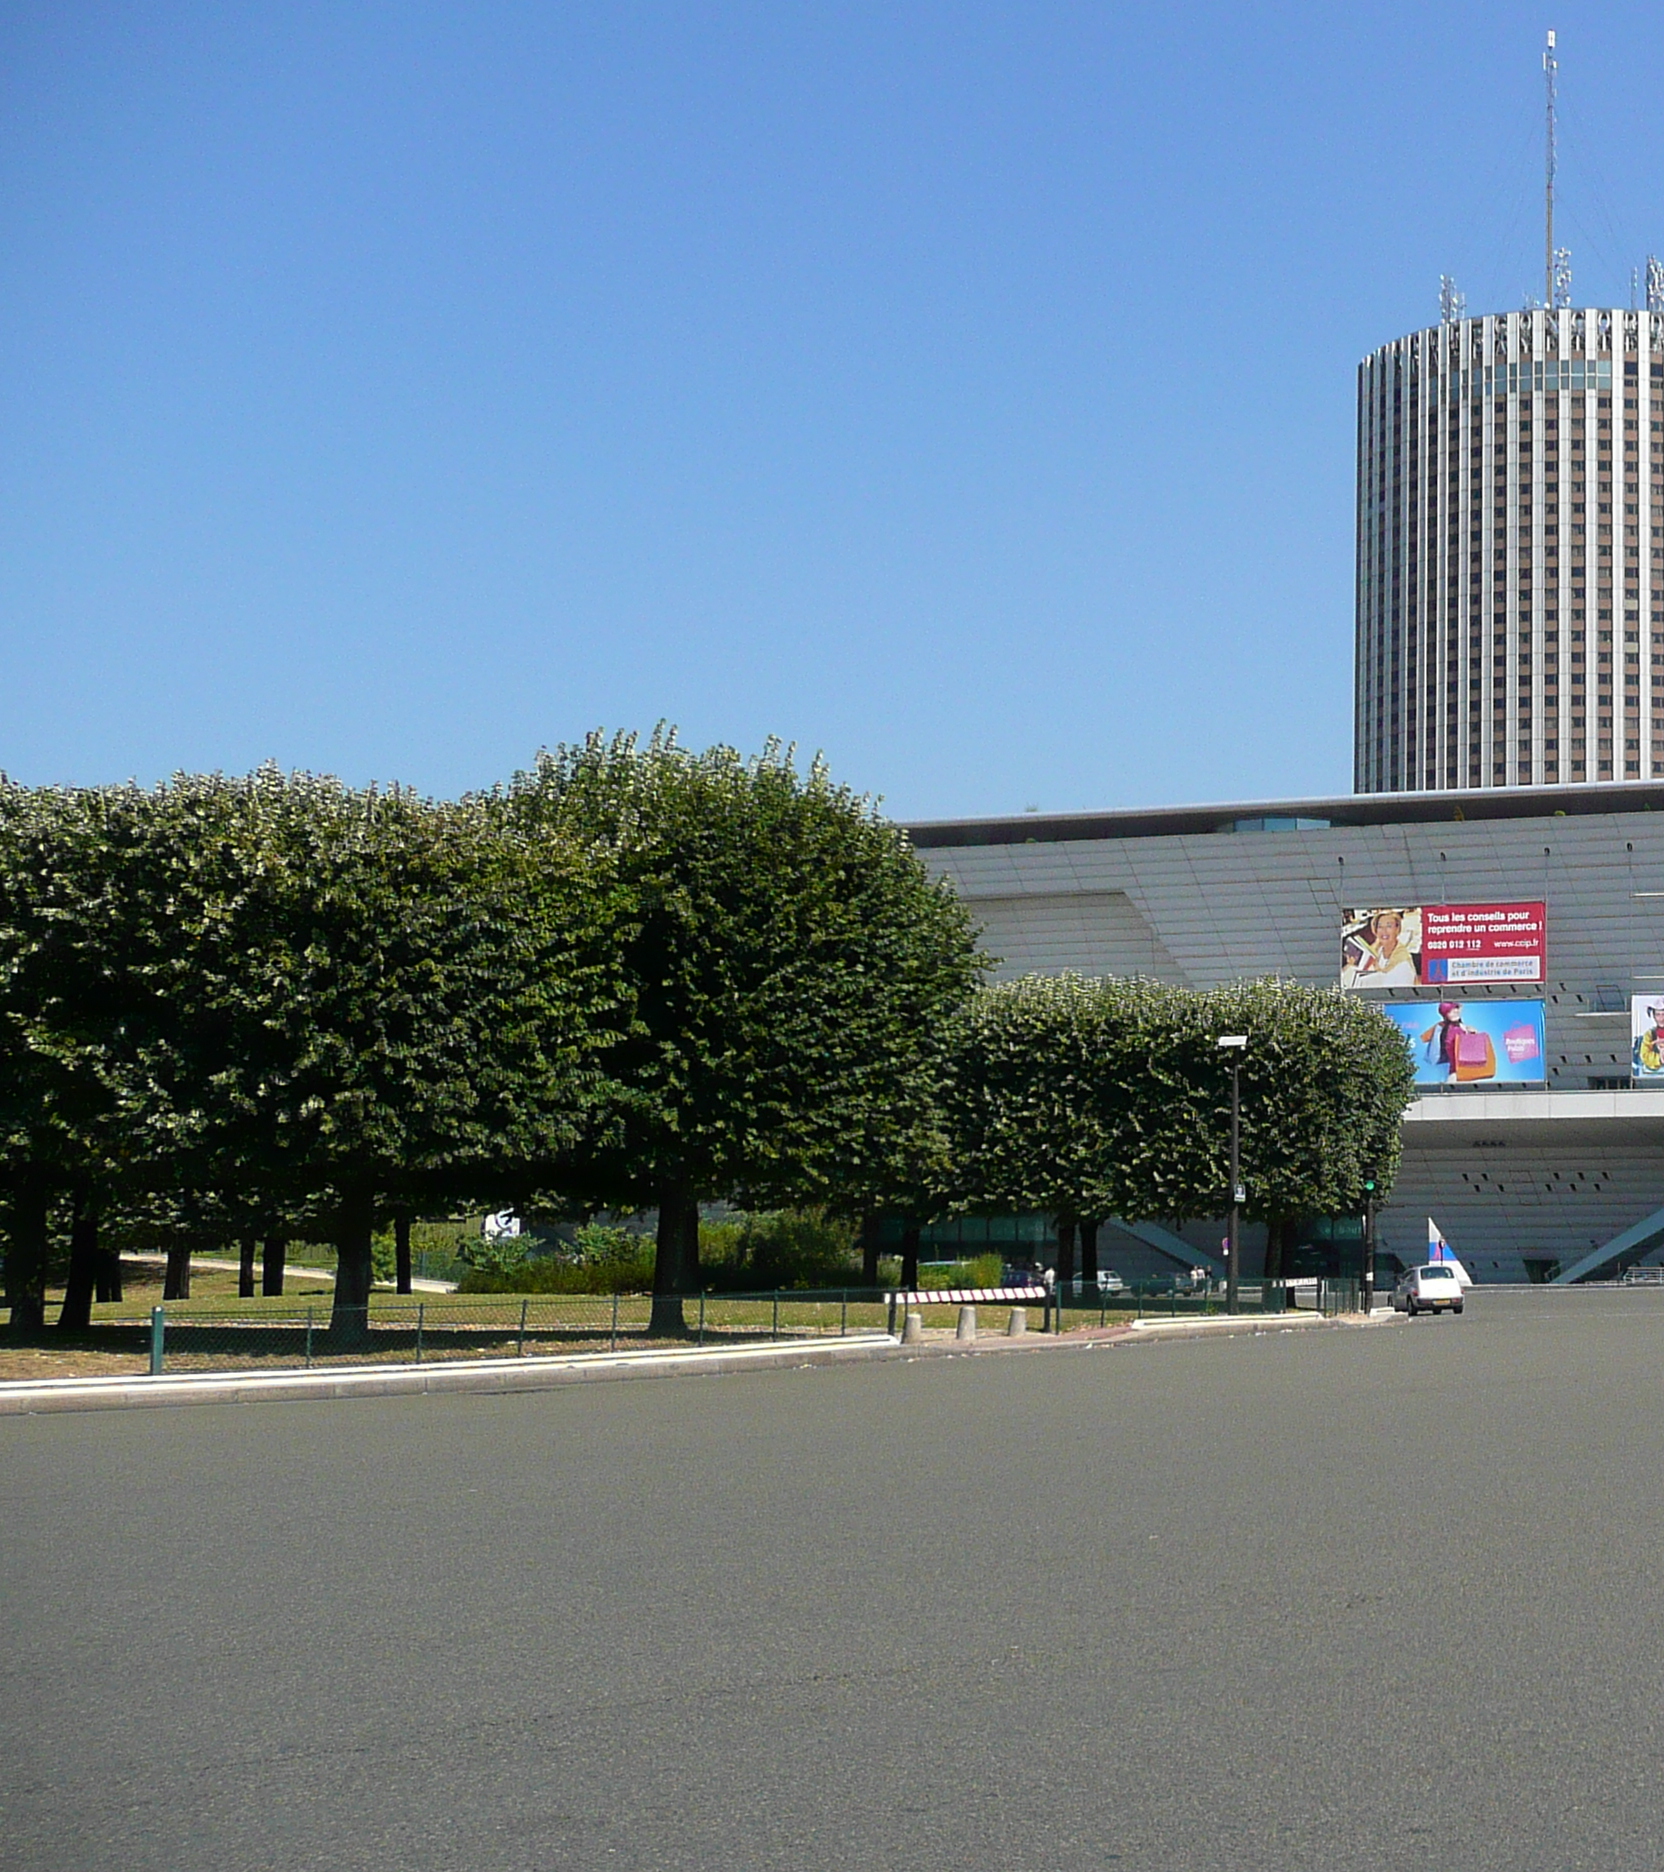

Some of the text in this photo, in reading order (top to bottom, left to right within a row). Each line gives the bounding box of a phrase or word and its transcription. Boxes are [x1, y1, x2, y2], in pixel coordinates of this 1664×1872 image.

[1427, 911, 1529, 922] Tous les conseils pour
[1428, 924, 1472, 935] reprendre
[1474, 925, 1486, 933] un
[1488, 922, 1537, 932] commerce
[1452, 960, 1483, 968] Chambre
[1485, 960, 1494, 968] de
